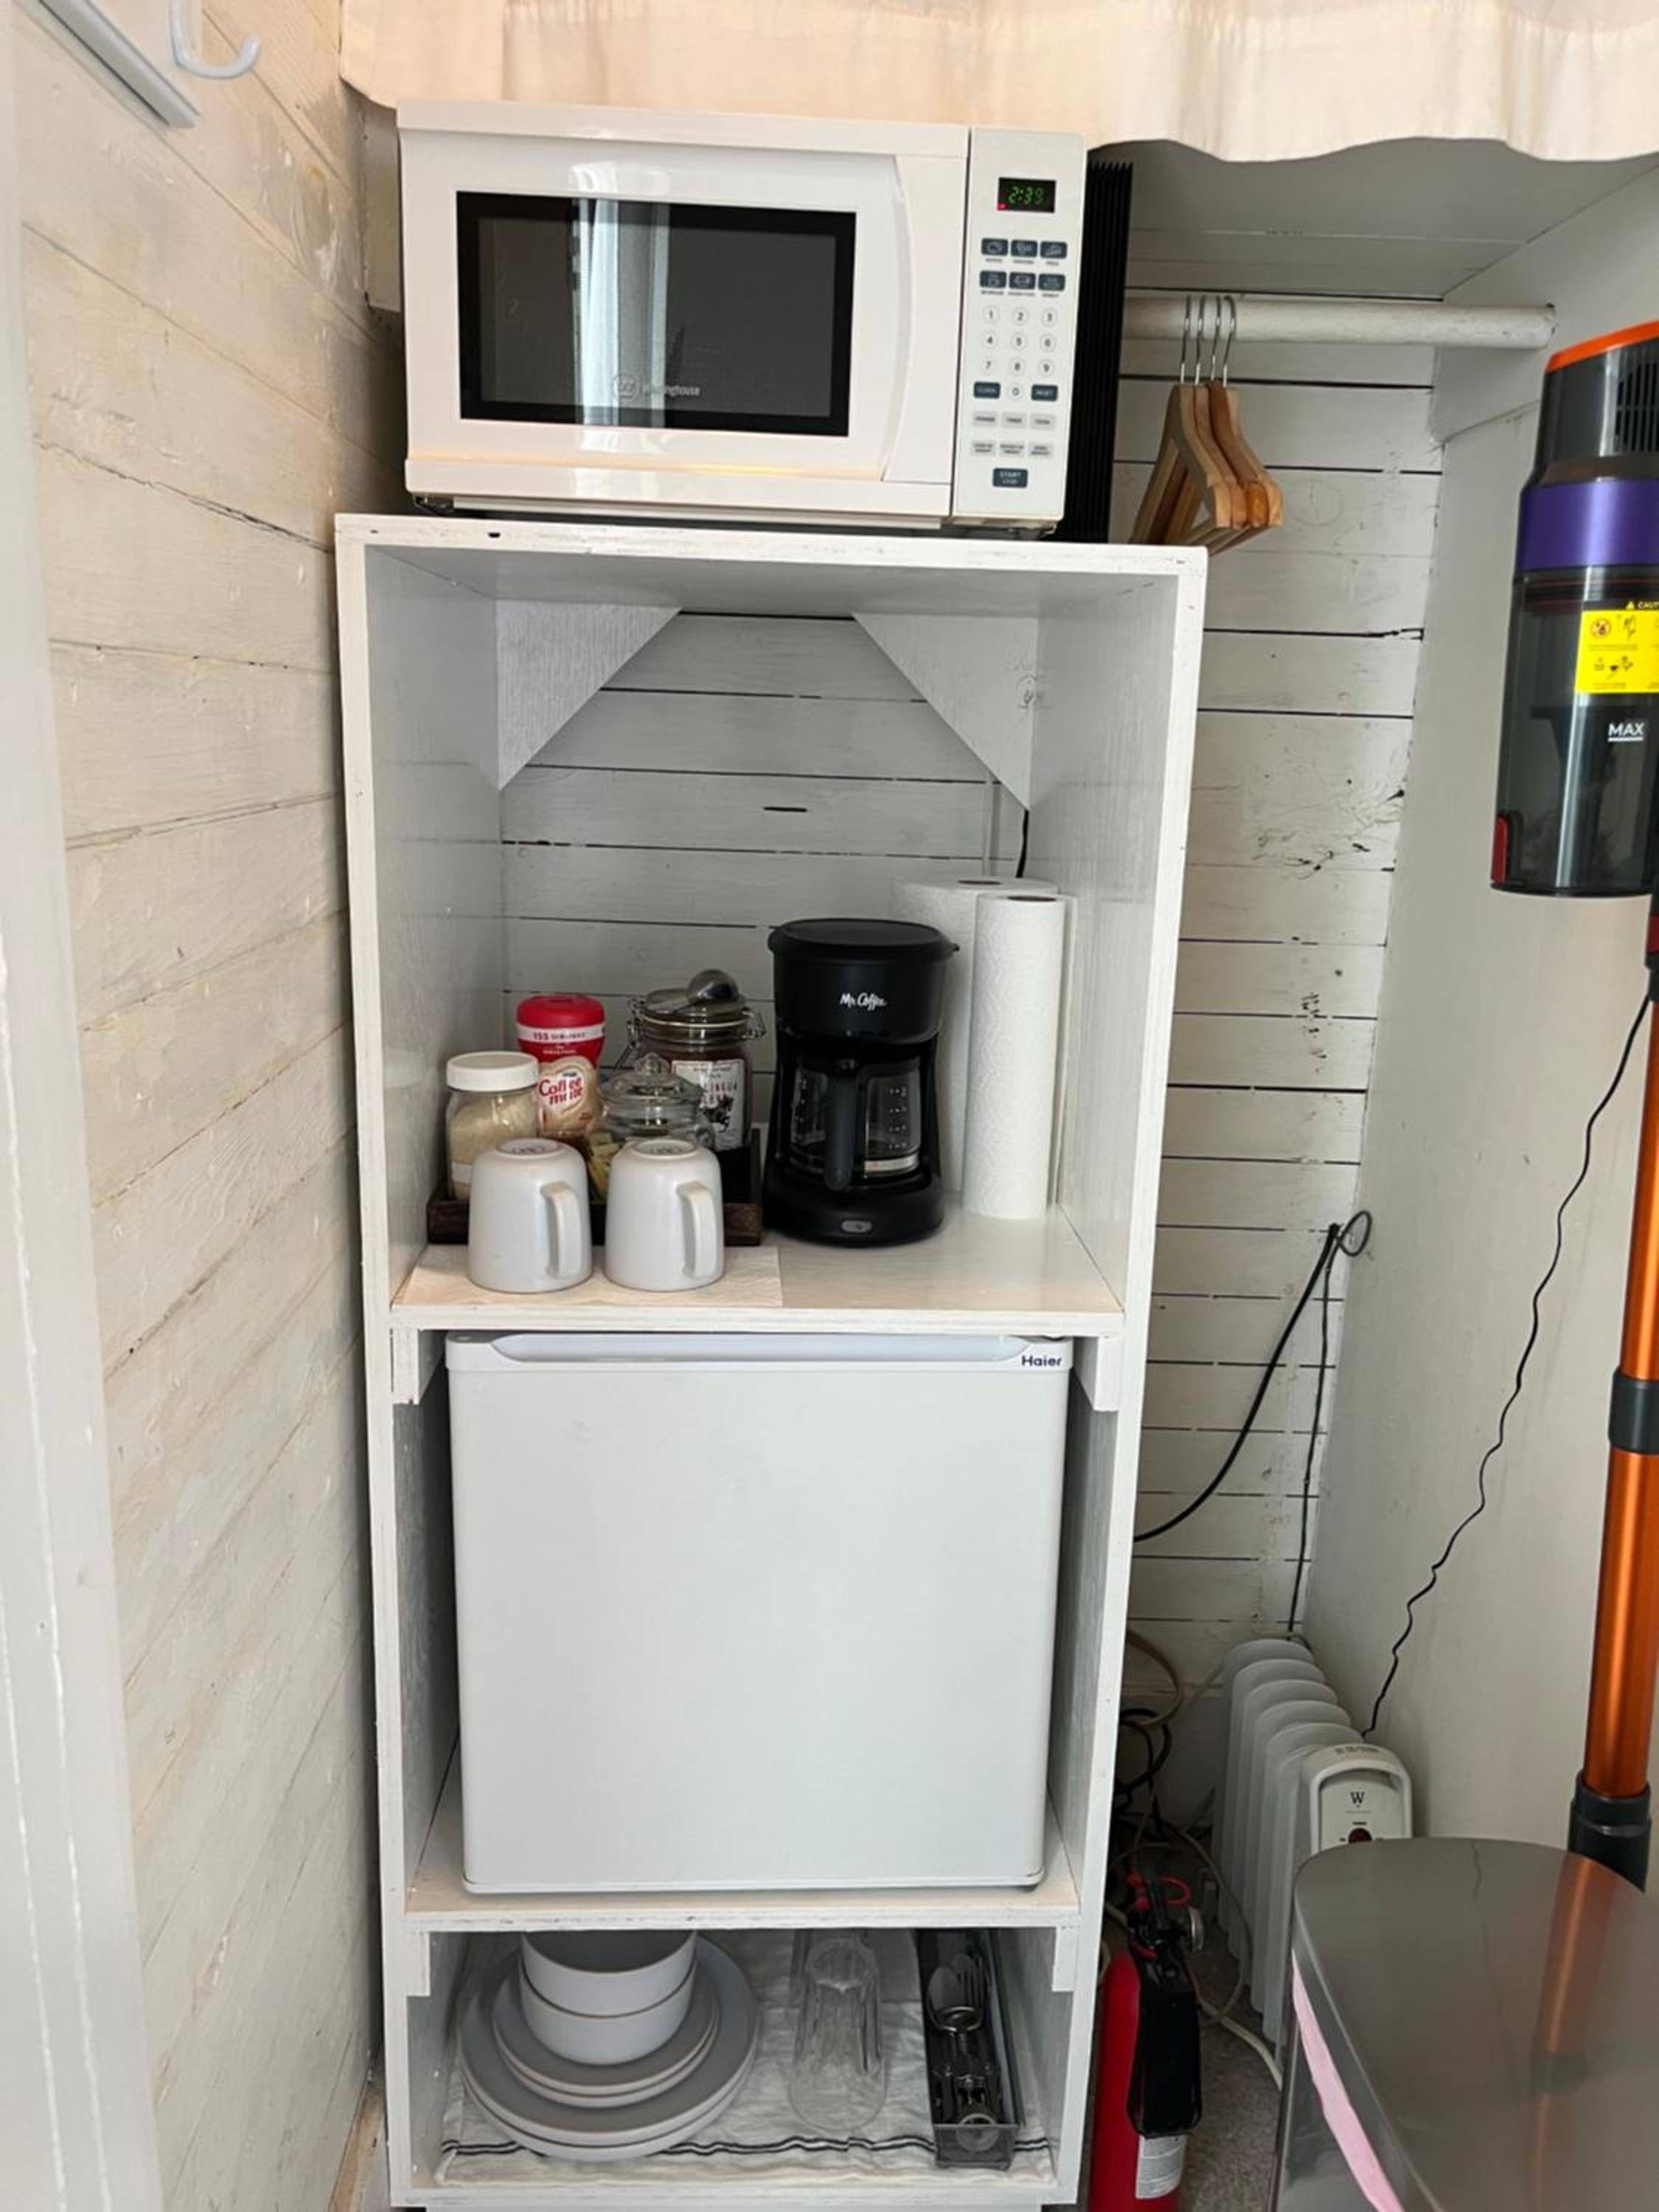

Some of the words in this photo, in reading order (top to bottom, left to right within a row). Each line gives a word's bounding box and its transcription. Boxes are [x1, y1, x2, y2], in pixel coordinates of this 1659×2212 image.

[1012, 388, 1019, 396] 0
[1608, 723, 1644, 737] MAX
[1021, 1355, 1062, 1366] Haier
[1350, 1791, 1365, 1804] W
